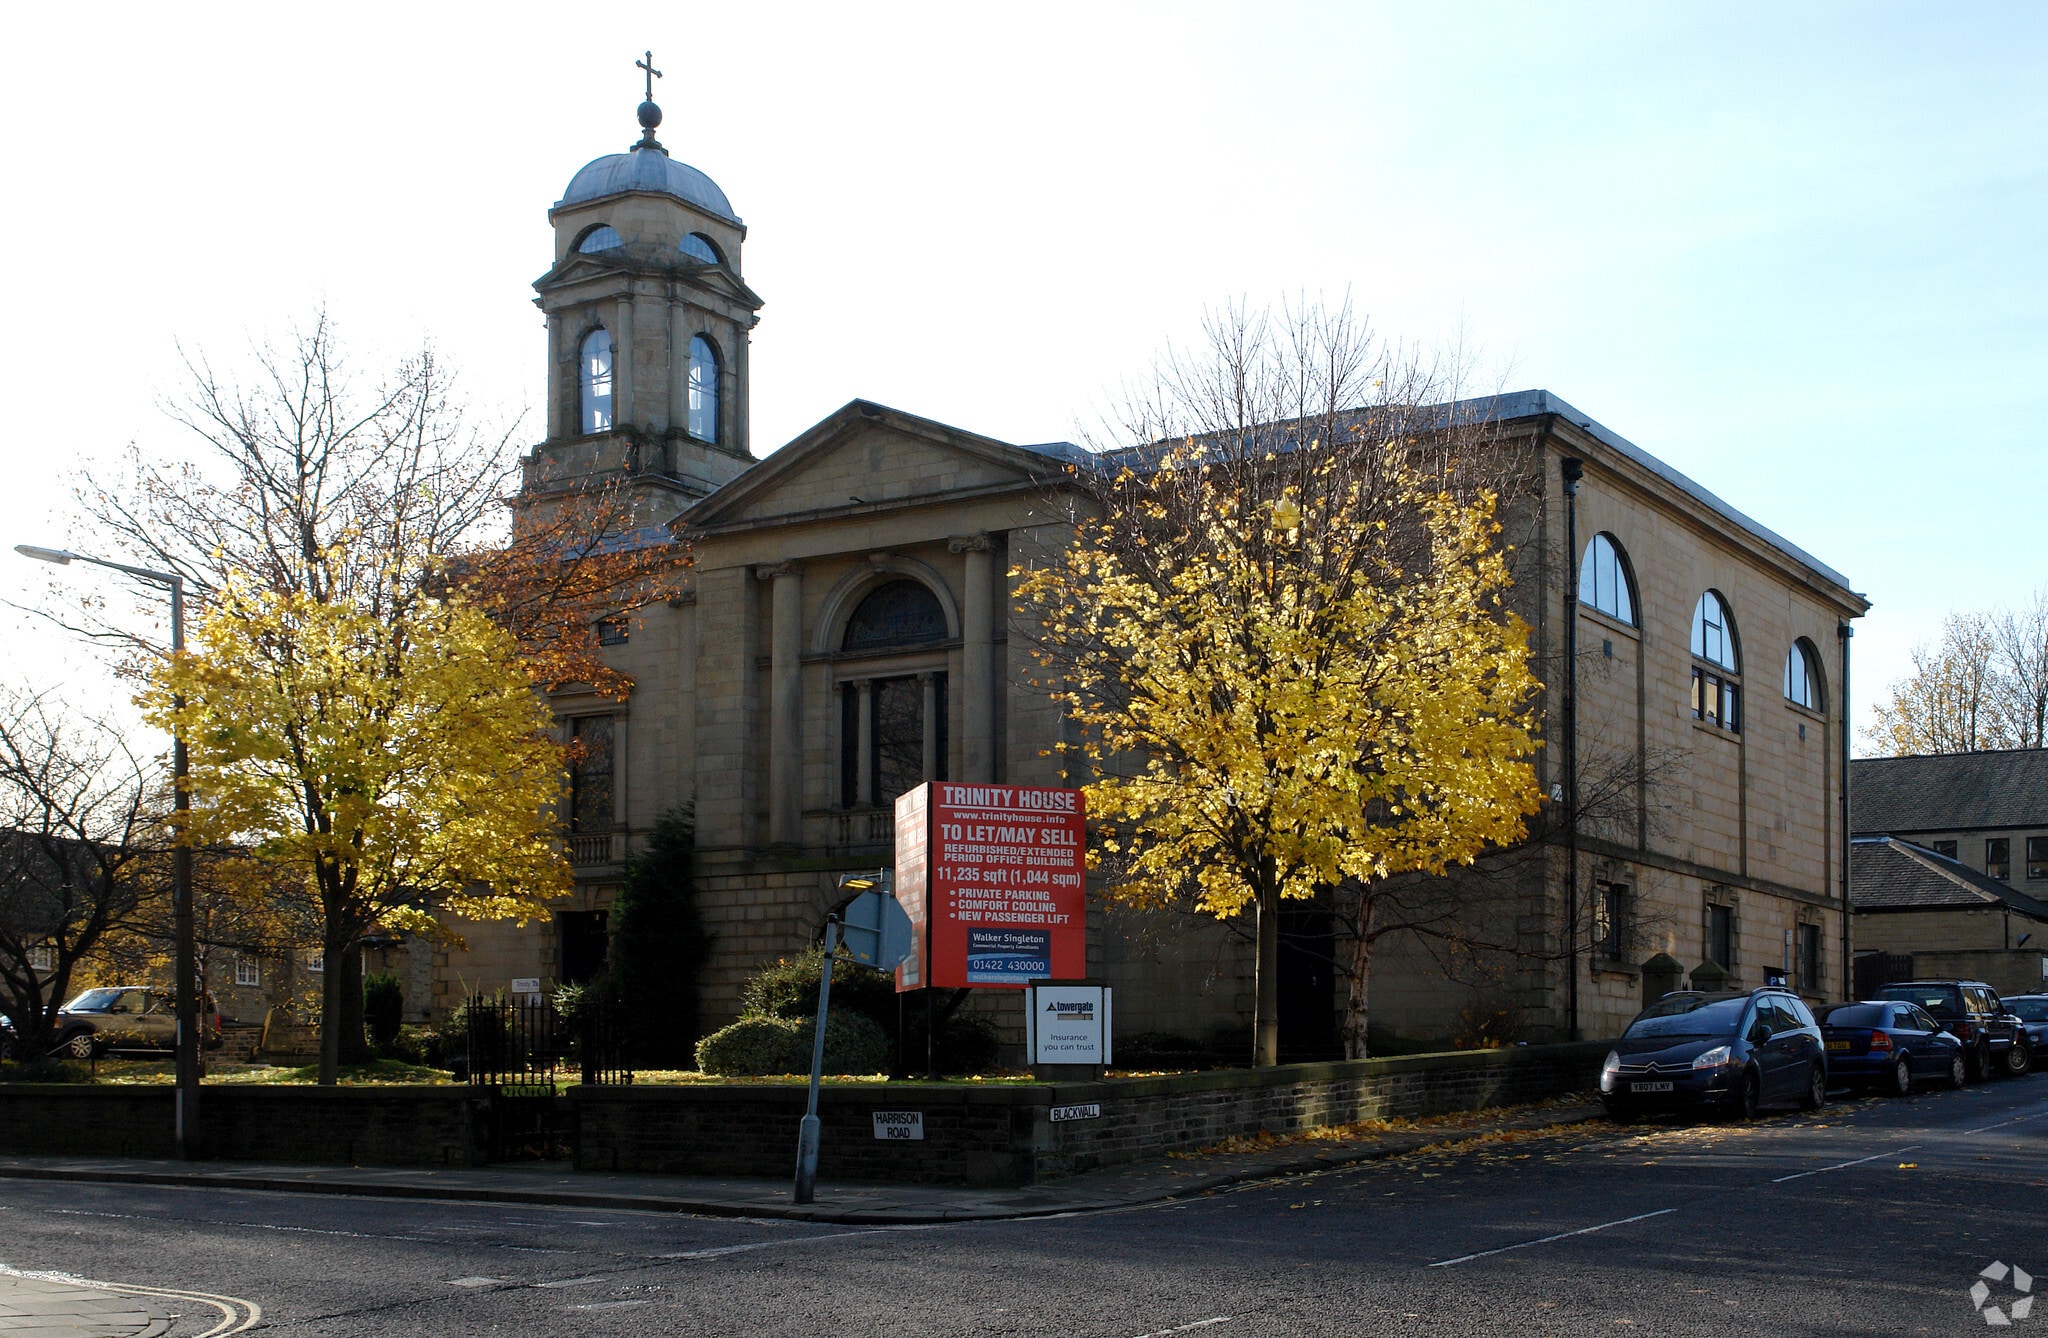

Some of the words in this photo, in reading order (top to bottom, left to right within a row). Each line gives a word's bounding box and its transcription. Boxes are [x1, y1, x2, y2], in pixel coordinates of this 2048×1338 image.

[943, 786, 1013, 807] TRINITY
[1018, 790, 1076, 810] HOUSE
[953, 811, 1066, 824] www.trinityhouse.info
[941, 823, 962, 841] TO
[966, 824, 1036, 844] LET/MAY
[1040, 828, 1078, 846] SELL
[944, 843, 1074, 858] REFURBISHED/EXTENDED
[944, 853, 983, 863] PERIOD
[986, 854, 1023, 866] OFFICE
[1026, 857, 1074, 867] BUILDING
[937, 866, 980, 883] 11,235
[983, 868, 1008, 885] sqft
[1010, 869, 1049, 886] (1,044
[1052, 872, 1081, 888] sqm)
[958, 887, 1002, 899] PRIVATE
[1004, 890, 1050, 901] PARKING
[958, 899, 1009, 911] COMFORT
[1011, 901, 1056, 913] COOLING
[958, 910, 982, 921] NEW
[984, 912, 1045, 923] PASSENGER
[1047, 914, 1070, 924] LIFT
[972, 932, 1002, 942] Walker
[1003, 933, 1045, 944] Singleton
[973, 959, 1003, 971] 01422
[1007, 961, 1045, 972] 430000
[973, 974, 1044, 982] walkersingleton.ck
[1057, 1001, 1094, 1014] towergate
[1050, 1033, 1088, 1041] Insurance
[1044, 1044, 1058, 1052] you
[875, 1112, 919, 1124] HARRISON
[1053, 1105, 1097, 1120] BLACKWALL
[887, 1127, 910, 1138] ROAD
